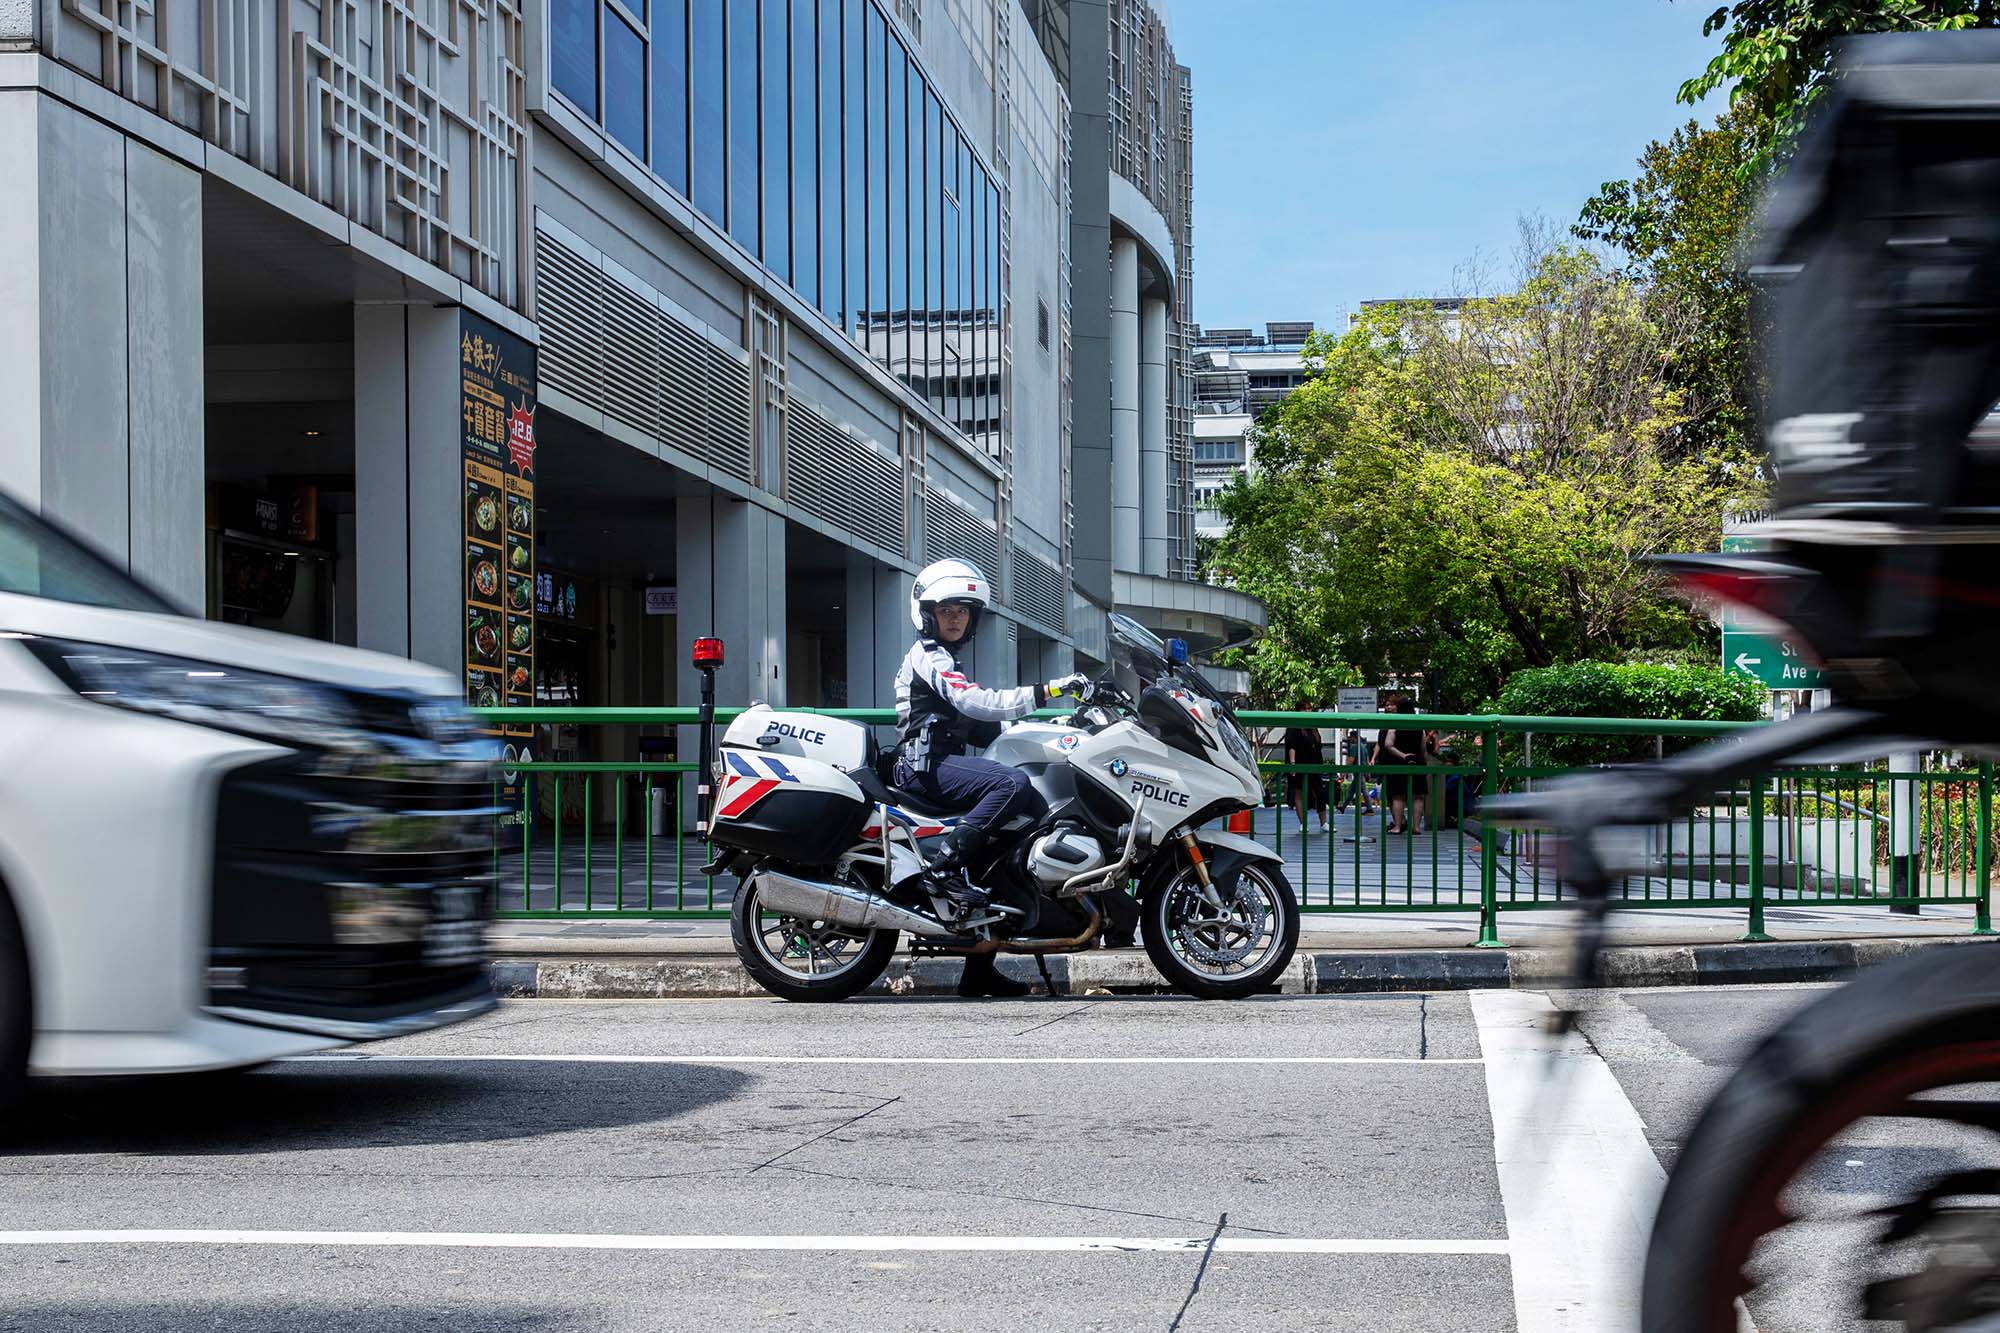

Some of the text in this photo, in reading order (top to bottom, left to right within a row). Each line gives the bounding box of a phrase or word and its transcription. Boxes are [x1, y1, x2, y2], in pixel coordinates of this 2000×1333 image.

[461, 330, 495, 374] 金筷子
[463, 396, 505, 445] 午餐套餐
[1782, 663, 1807, 679] Ave
[767, 720, 827, 745] POLICE
[1130, 780, 1190, 808] POLICE
